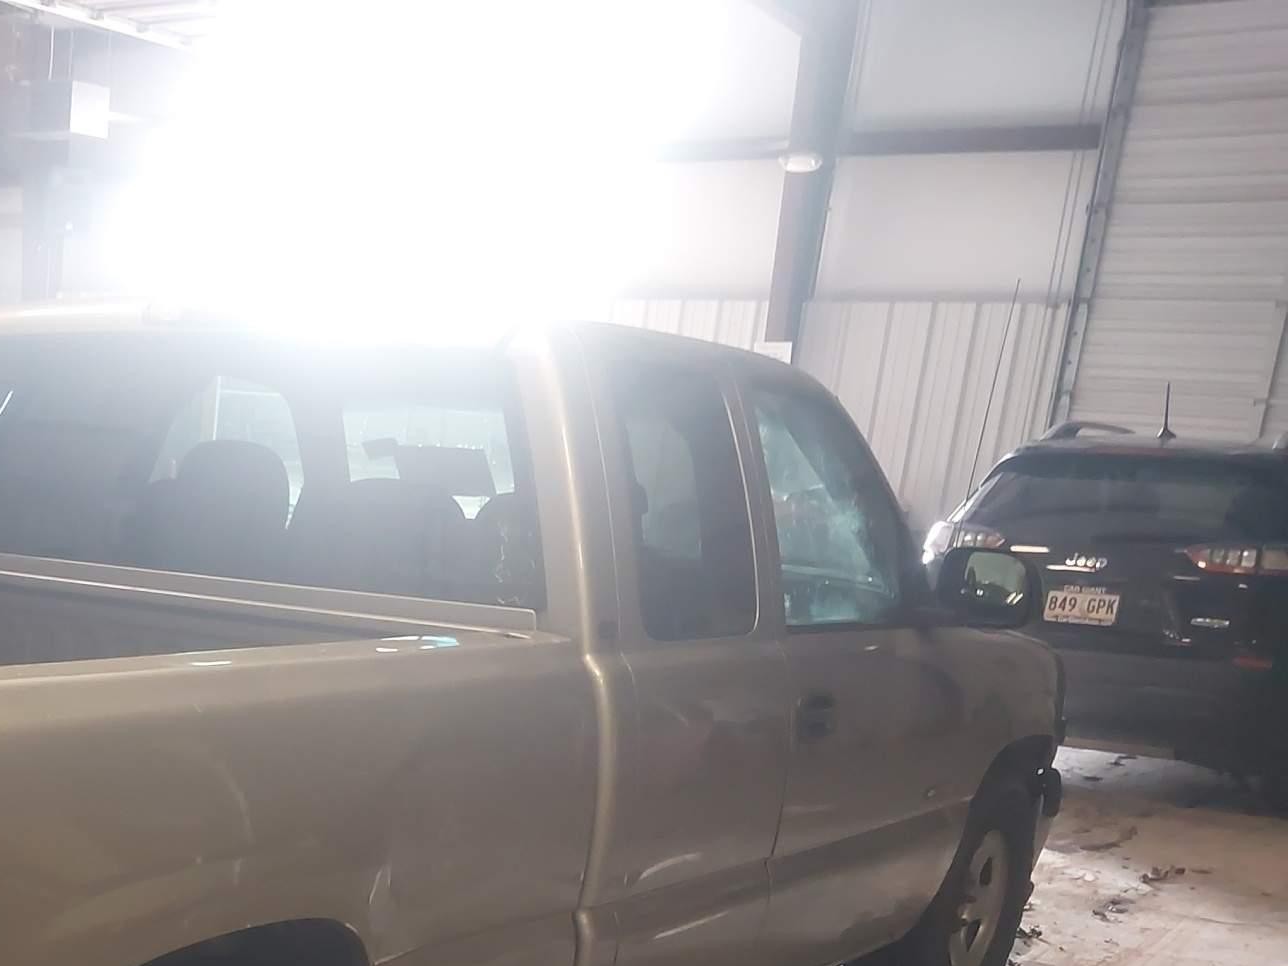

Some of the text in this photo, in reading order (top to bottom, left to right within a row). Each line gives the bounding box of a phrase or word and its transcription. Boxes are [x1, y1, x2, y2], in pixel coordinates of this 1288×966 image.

[1065, 552, 1108, 571] Jeep
[1048, 595, 1116, 615] 849 GPK
